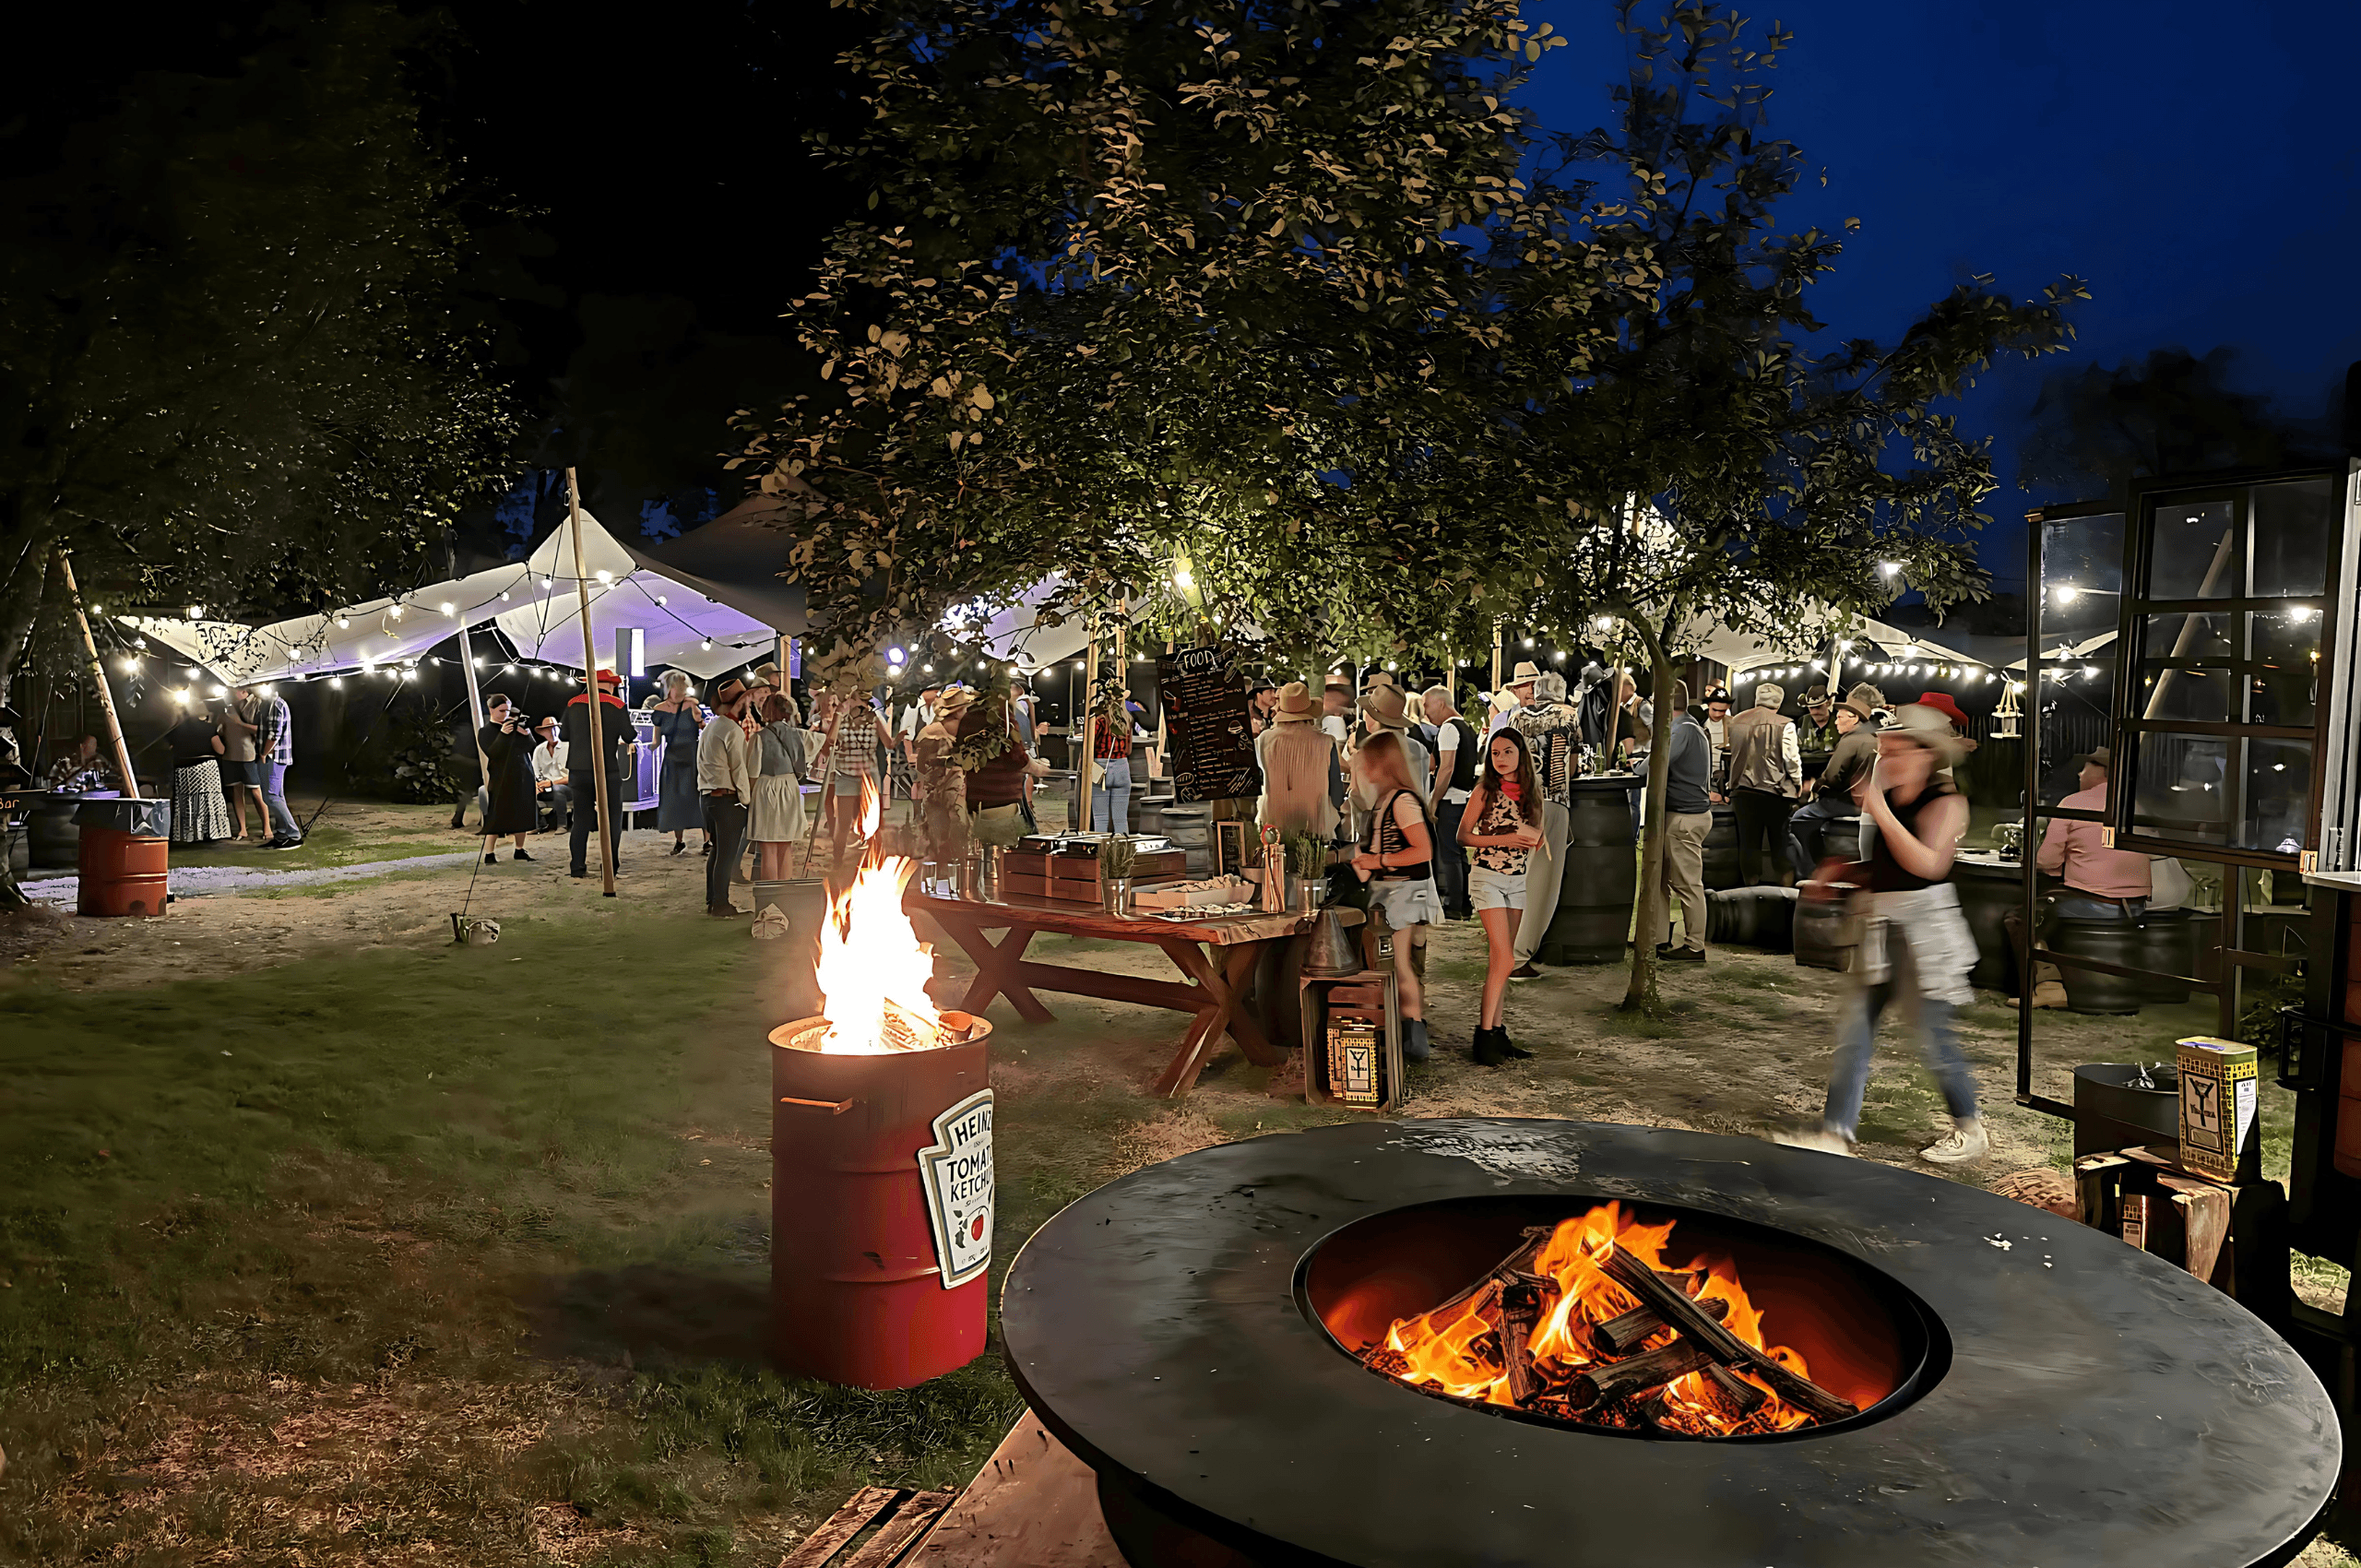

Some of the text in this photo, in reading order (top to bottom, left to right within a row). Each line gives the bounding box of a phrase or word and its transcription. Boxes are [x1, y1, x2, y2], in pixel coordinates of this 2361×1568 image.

[1183, 650, 1216, 670] FOOD
[954, 1110, 991, 1146] HEINZ
[950, 1164, 992, 1203] KETCHU
